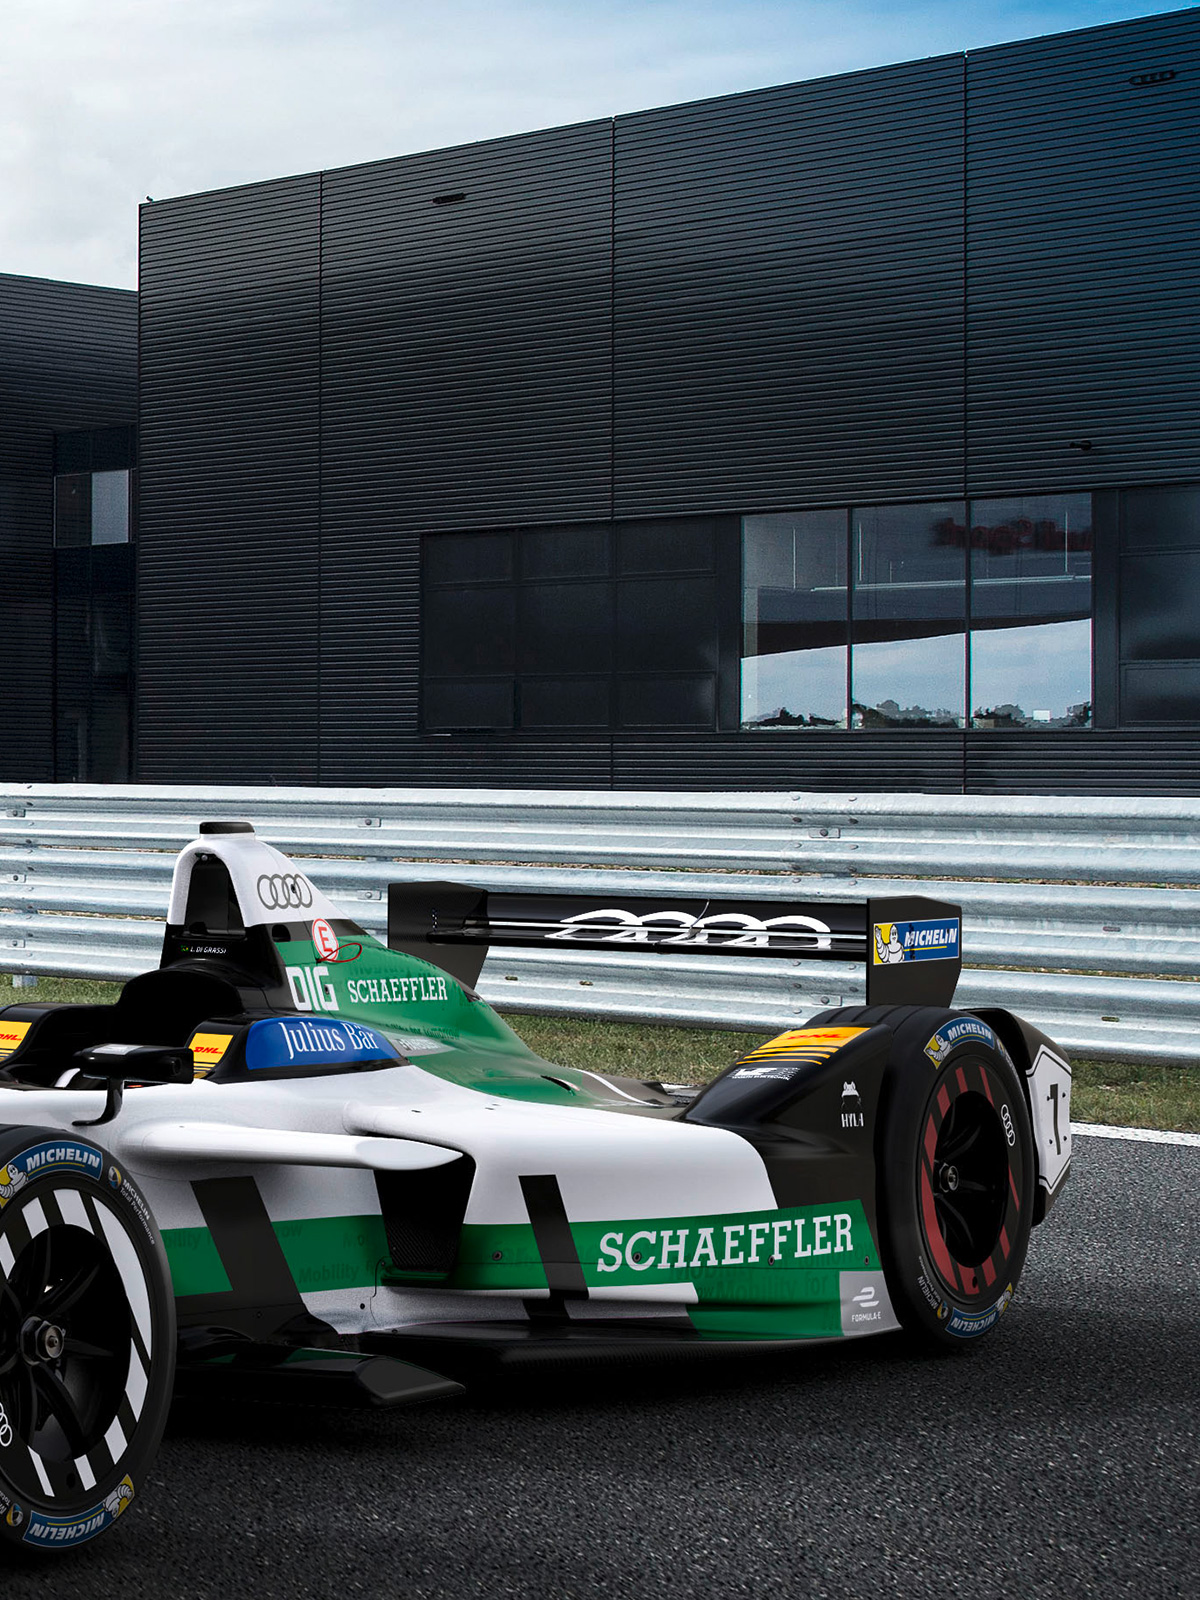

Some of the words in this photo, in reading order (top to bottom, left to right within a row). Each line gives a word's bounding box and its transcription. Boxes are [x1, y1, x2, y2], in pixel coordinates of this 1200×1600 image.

[318, 926, 333, 953] E
[904, 928, 957, 947] MICHELIN
[285, 966, 339, 1011] DIG
[347, 976, 448, 1004] SCHAEFFLER
[279, 1021, 344, 1060] Julius
[345, 1023, 379, 1050] Bär
[947, 1023, 992, 1041] MICHELIN
[1050, 1083, 1061, 1155] 1
[26, 1149, 100, 1172] MICHELIN
[123, 1179, 150, 1220] MICHELIN
[131, 1200, 155, 1245] Performance
[597, 1214, 854, 1273] SCHAEFFLER
[951, 1312, 997, 1331] MICHELIN
[29, 1512, 105, 1541] MICHELIN
